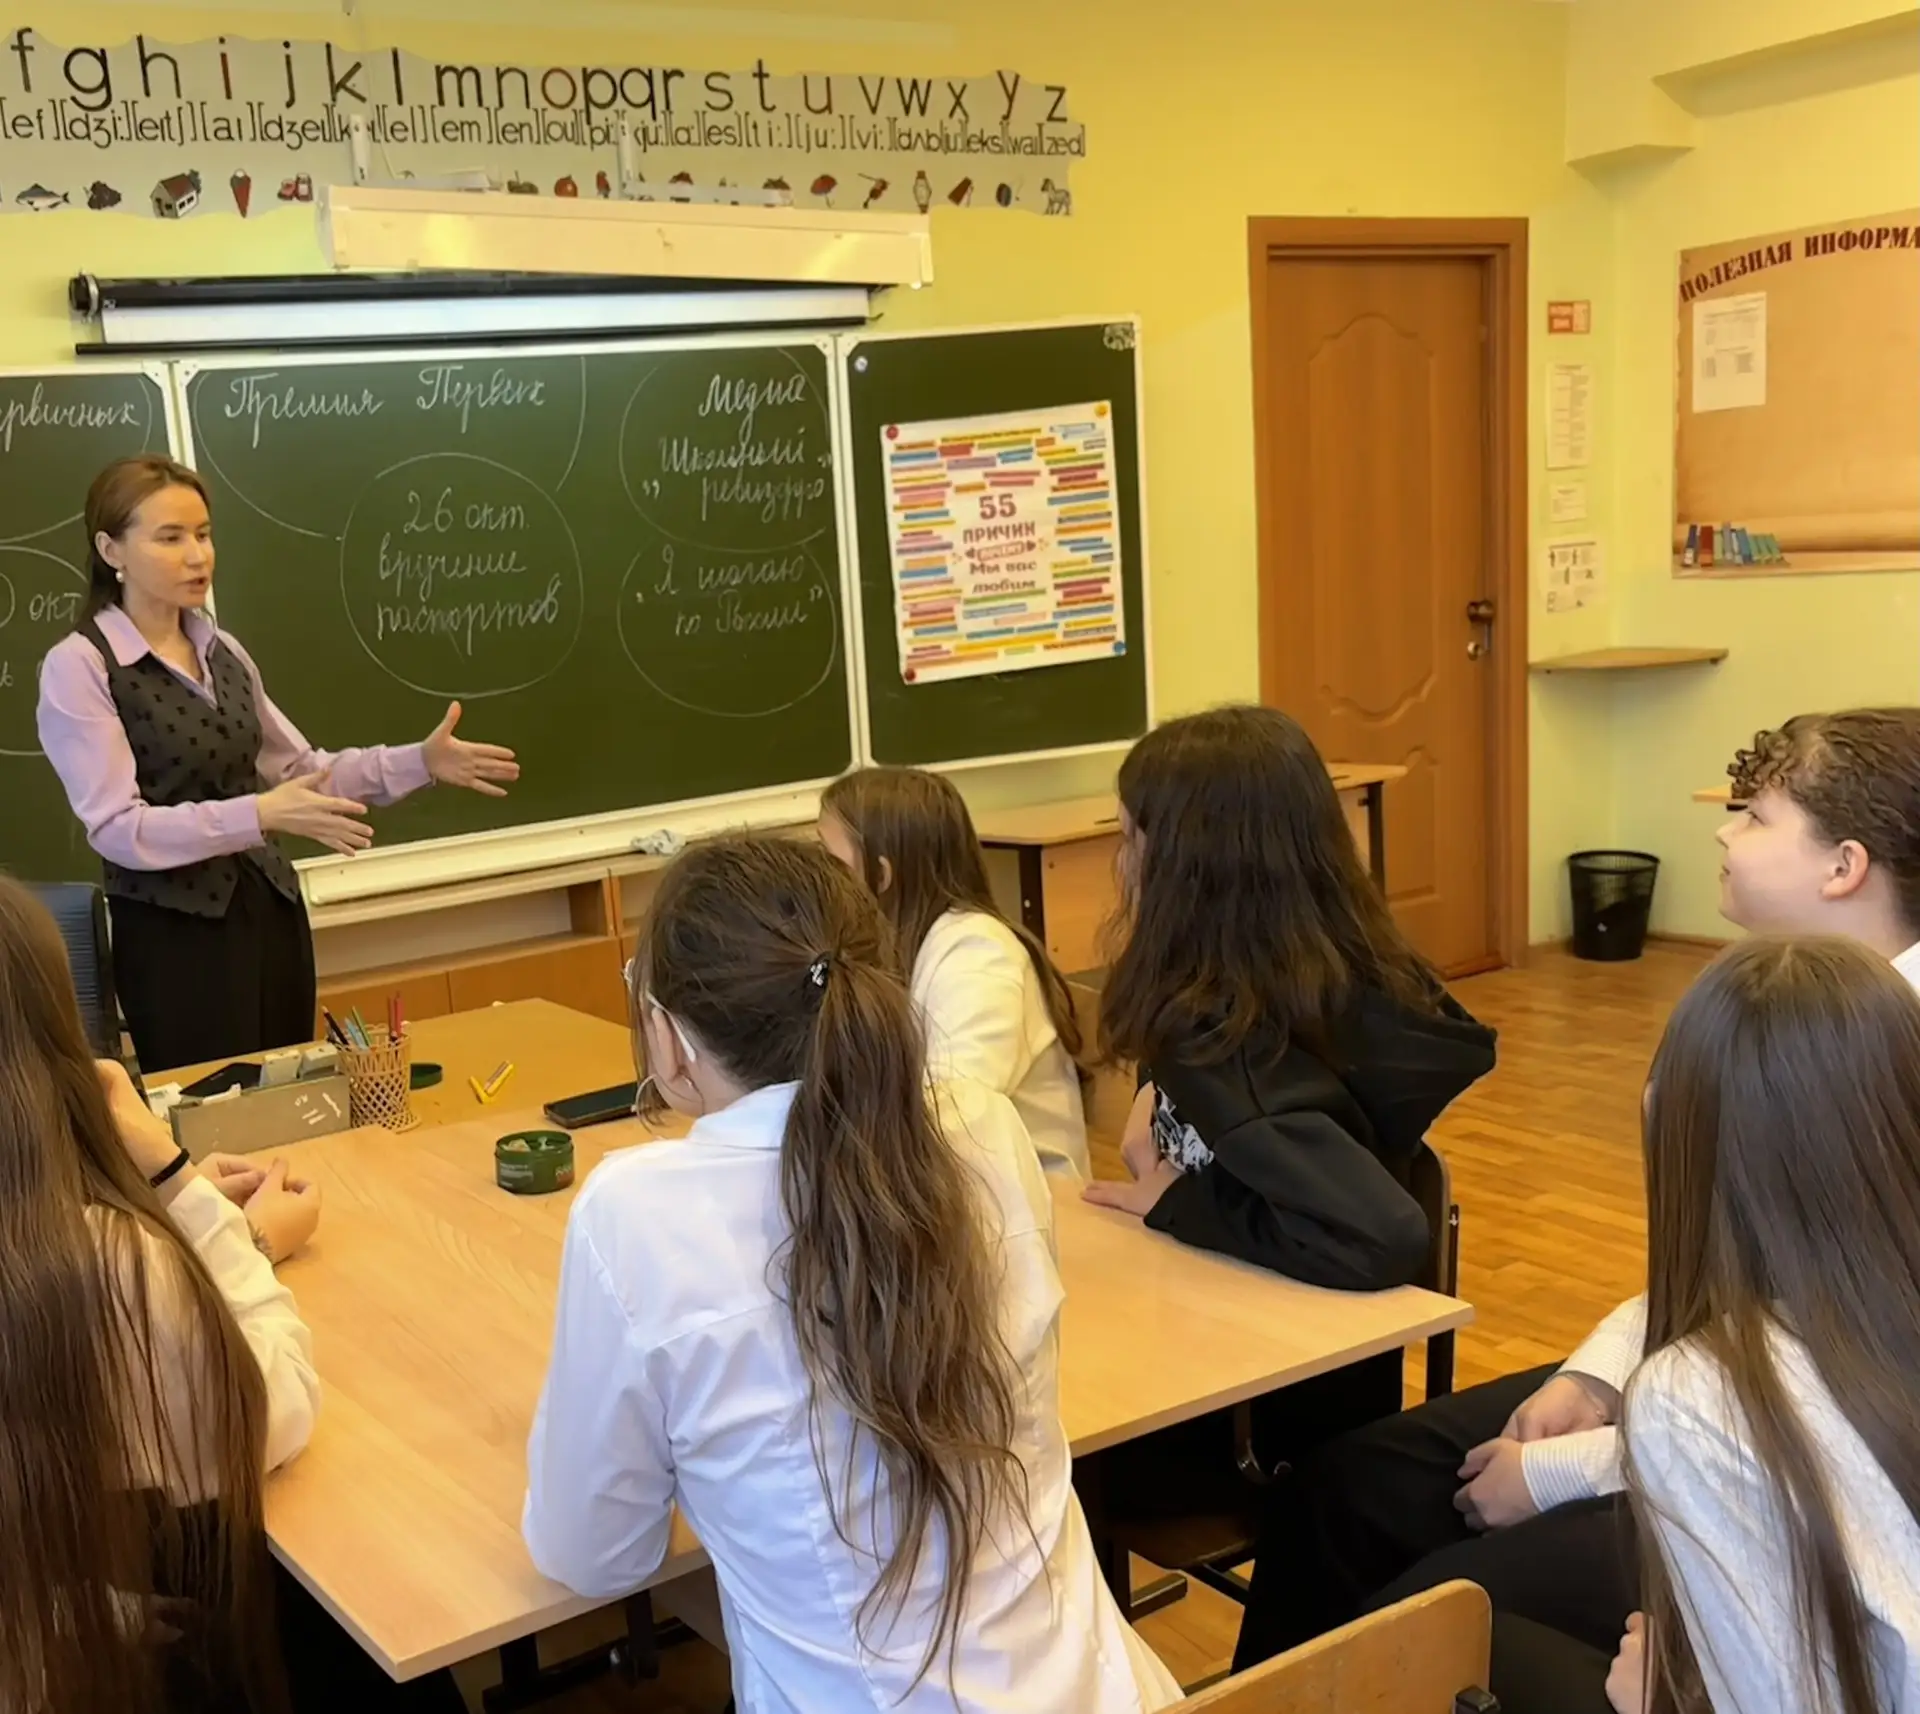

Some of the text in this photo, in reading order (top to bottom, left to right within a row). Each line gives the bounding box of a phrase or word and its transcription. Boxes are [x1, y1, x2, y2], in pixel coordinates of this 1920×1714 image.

[10, 27, 35, 93] f
[63, 47, 113, 112] g
[136, 33, 182, 99] h
[218, 36, 233, 100] i
[282, 40, 296, 109] j
[325, 41, 367, 104] k
[435, 64, 484, 108] m
[496, 66, 531, 110] n
[541, 67, 577, 110] o
[582, 67, 618, 126] p
[619, 67, 657, 121] q
[663, 69, 685, 111] r
[704, 71, 734, 112] s
[752, 58, 777, 112] t
[803, 75, 832, 115] u
[858, 76, 884, 115] v
[896, 77, 932, 117] w
[947, 81, 969, 120] x
[996, 69, 1020, 121] y
[1045, 84, 1068, 122] z
[1679, 240, 1792, 303] ПОЛЕЗНАЯ
[0, 382, 140, 452] рвичных
[403, 487, 454, 534] 26
[962, 520, 1036, 545] ПРИЧИН
[979, 493, 1018, 520] 55
